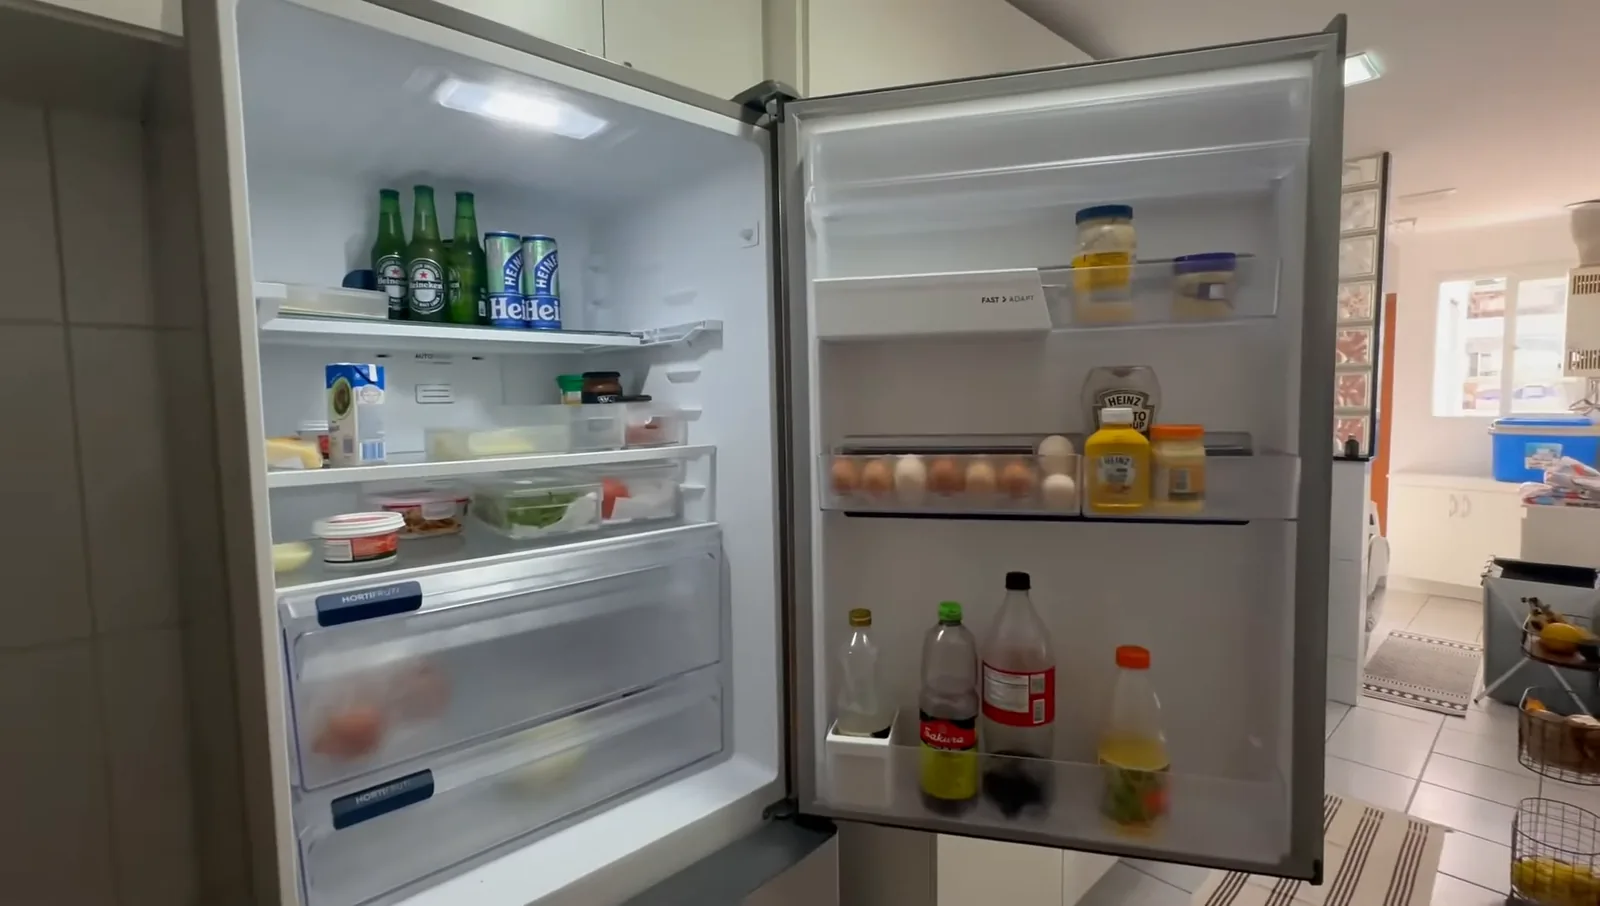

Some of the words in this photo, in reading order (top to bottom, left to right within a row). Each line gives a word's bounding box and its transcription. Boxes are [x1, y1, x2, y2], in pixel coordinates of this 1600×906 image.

[981, 296, 999, 304] FAST
[1009, 294, 1034, 302] ADAPT
[1107, 395, 1141, 407] HEINZ
[924, 726, 964, 743] Sakura
